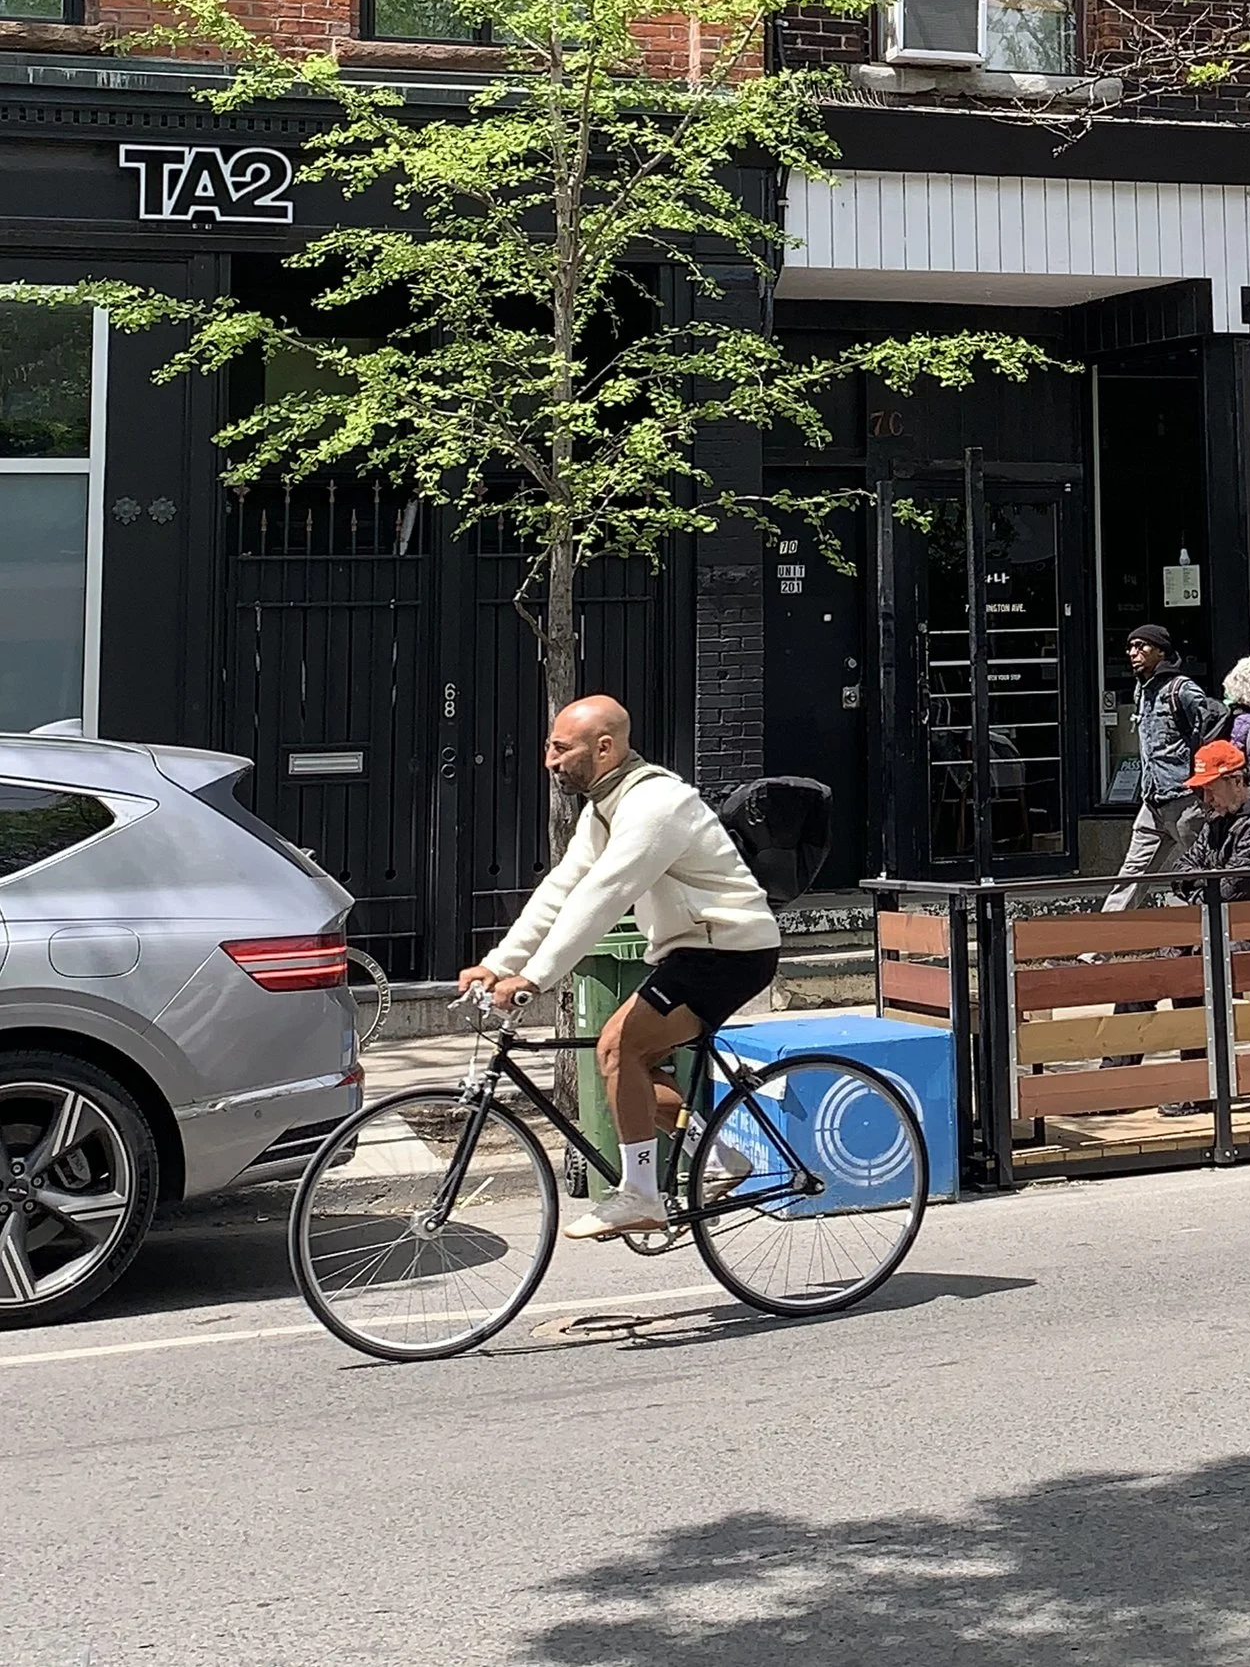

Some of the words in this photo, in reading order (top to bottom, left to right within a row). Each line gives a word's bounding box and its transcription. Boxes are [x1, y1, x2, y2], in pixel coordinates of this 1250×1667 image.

[119, 143, 294, 224] TA2
[870, 410, 904, 436] 70
[778, 565, 805, 578] UNIT
[781, 581, 802, 594] 201
[444, 683, 456, 718] 68
